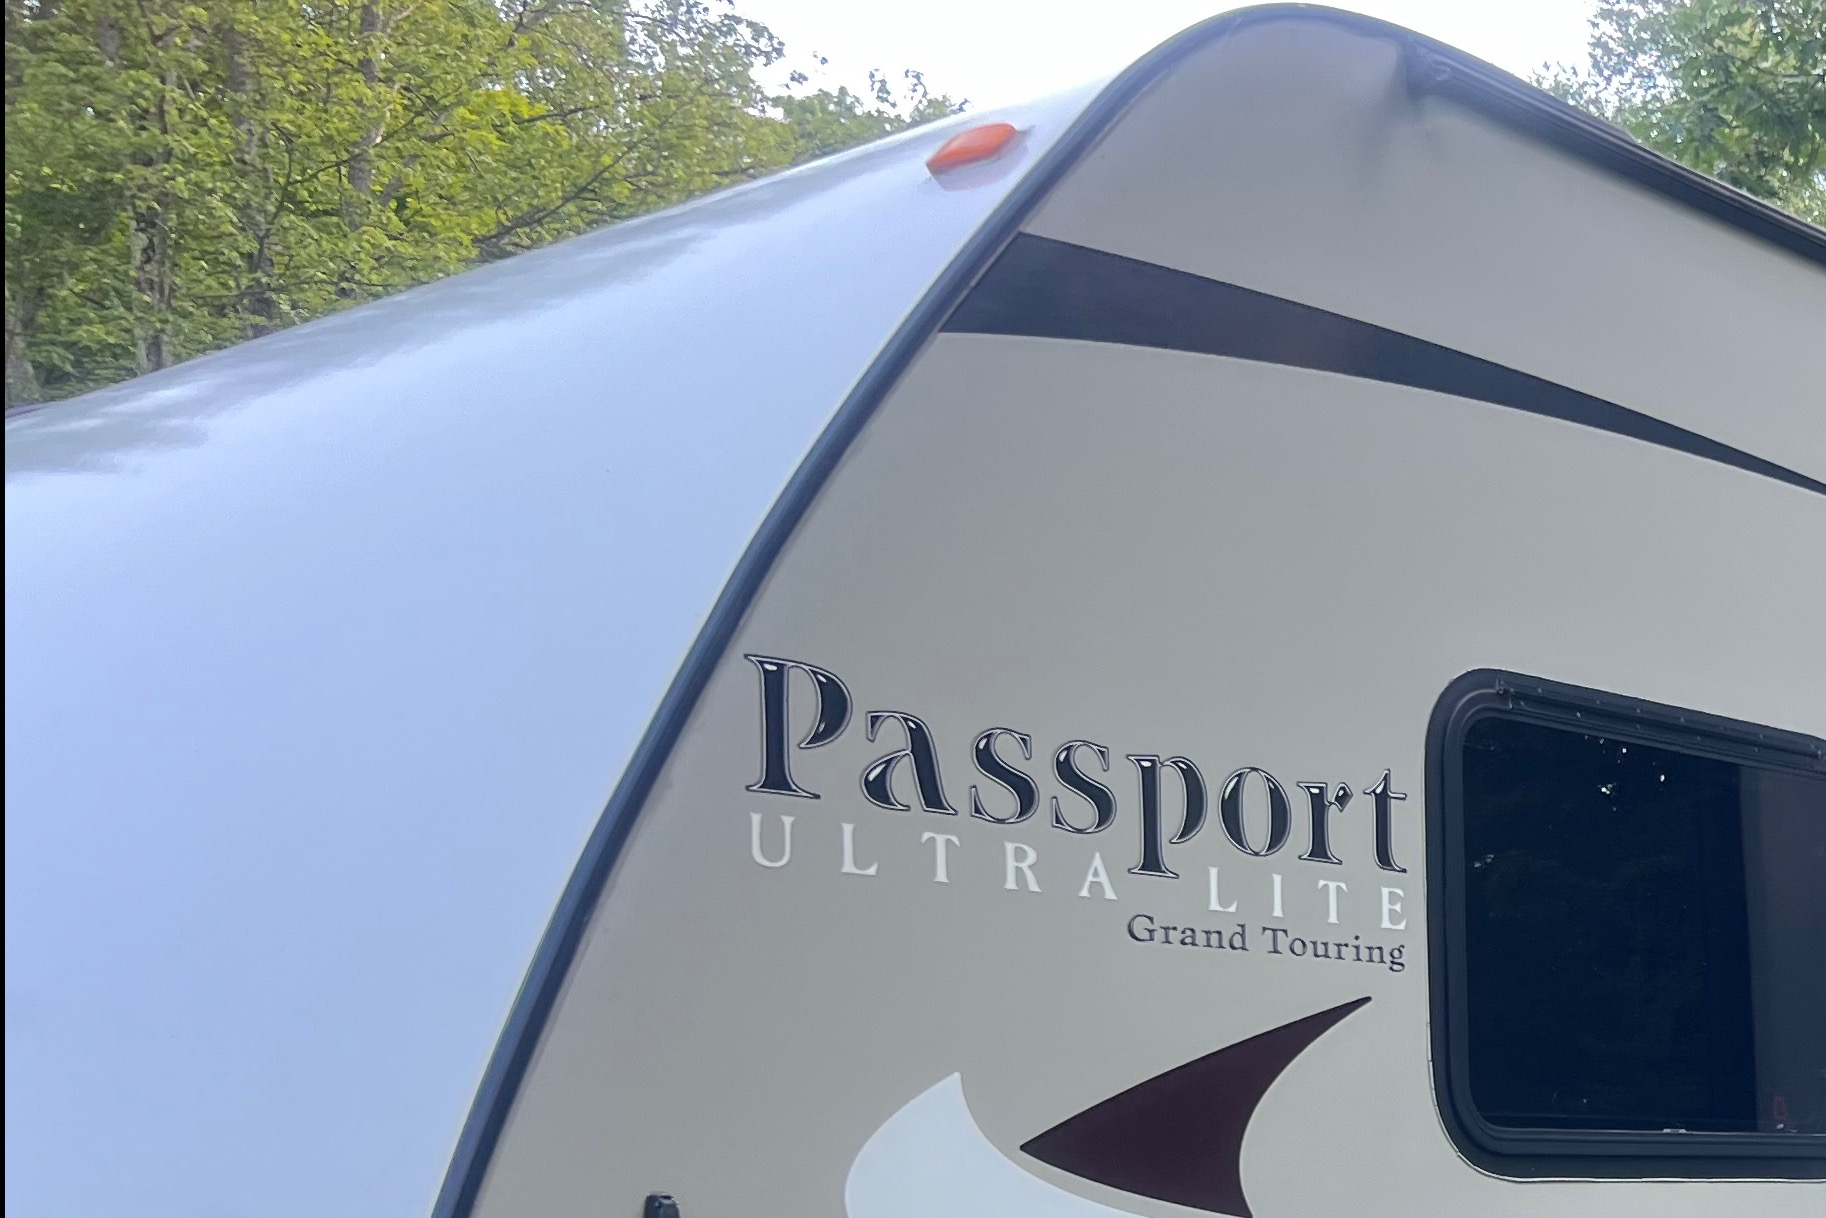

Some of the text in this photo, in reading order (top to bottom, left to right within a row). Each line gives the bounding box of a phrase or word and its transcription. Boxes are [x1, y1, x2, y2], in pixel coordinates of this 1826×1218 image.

[744, 653, 1408, 879] Passport
[749, 811, 1407, 931] ULTRA LITE
[1126, 913, 1406, 973] Grand Touring
